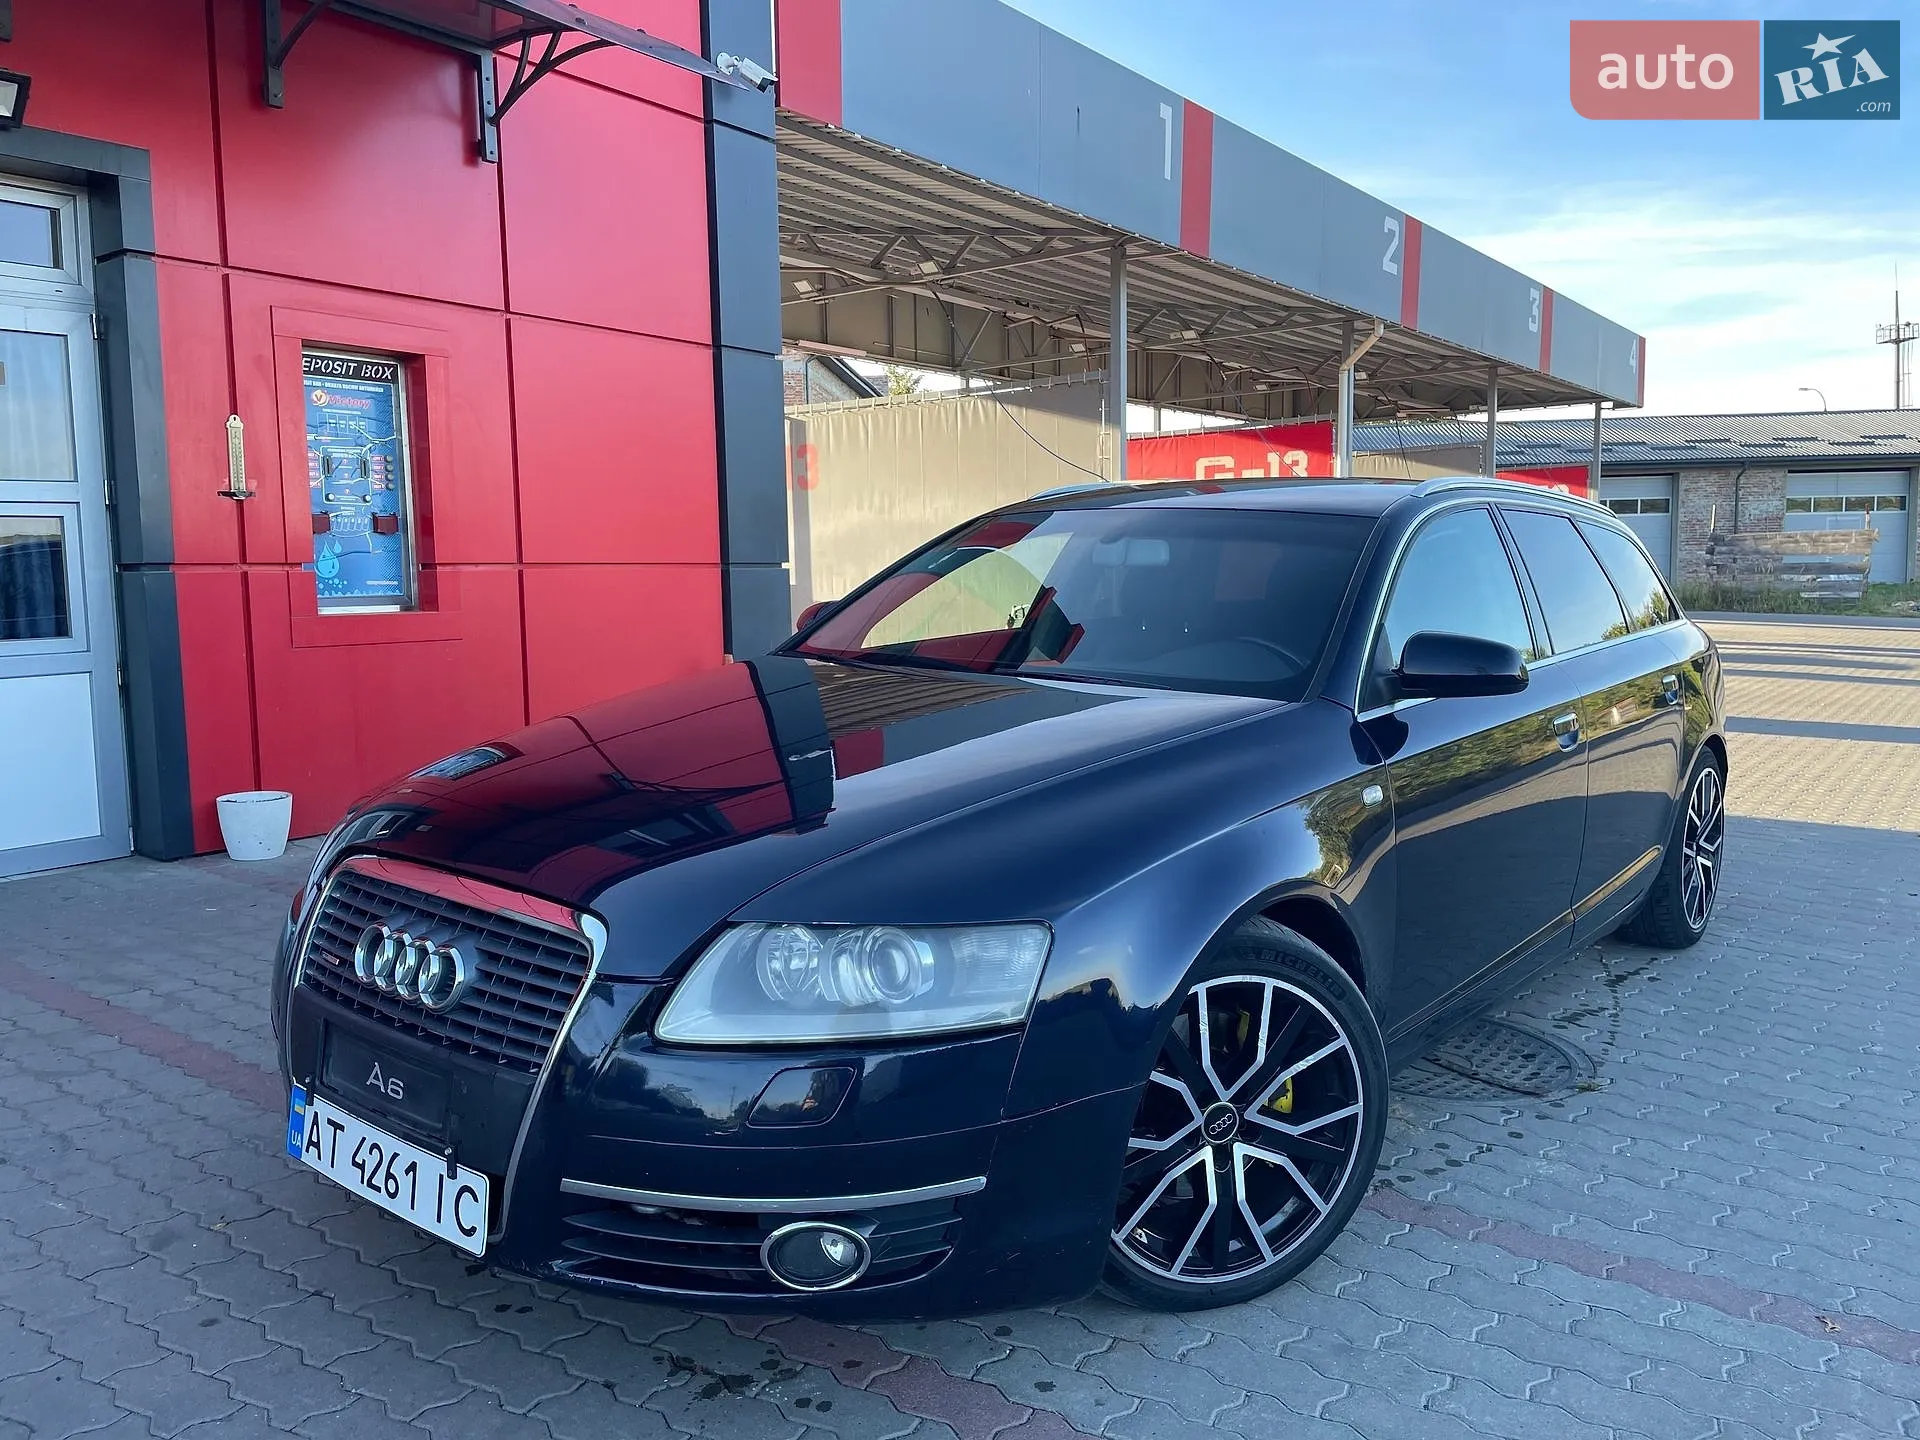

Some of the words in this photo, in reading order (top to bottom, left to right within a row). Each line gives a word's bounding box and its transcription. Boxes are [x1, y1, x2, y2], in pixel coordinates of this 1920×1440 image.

[1159, 102, 1173, 181] 1
[1382, 215, 1400, 276] 2
[1528, 287, 1540, 333] 3
[361, 363, 393, 380] BOX
[1629, 339, 1636, 374] 4
[1261, 951, 1347, 1000] MICHELIN
[365, 1061, 404, 1100] A6
[291, 1130, 301, 1148] UA
[305, 1110, 345, 1169] AT
[351, 1136, 418, 1212] 4261
[436, 1173, 479, 1238] IC
